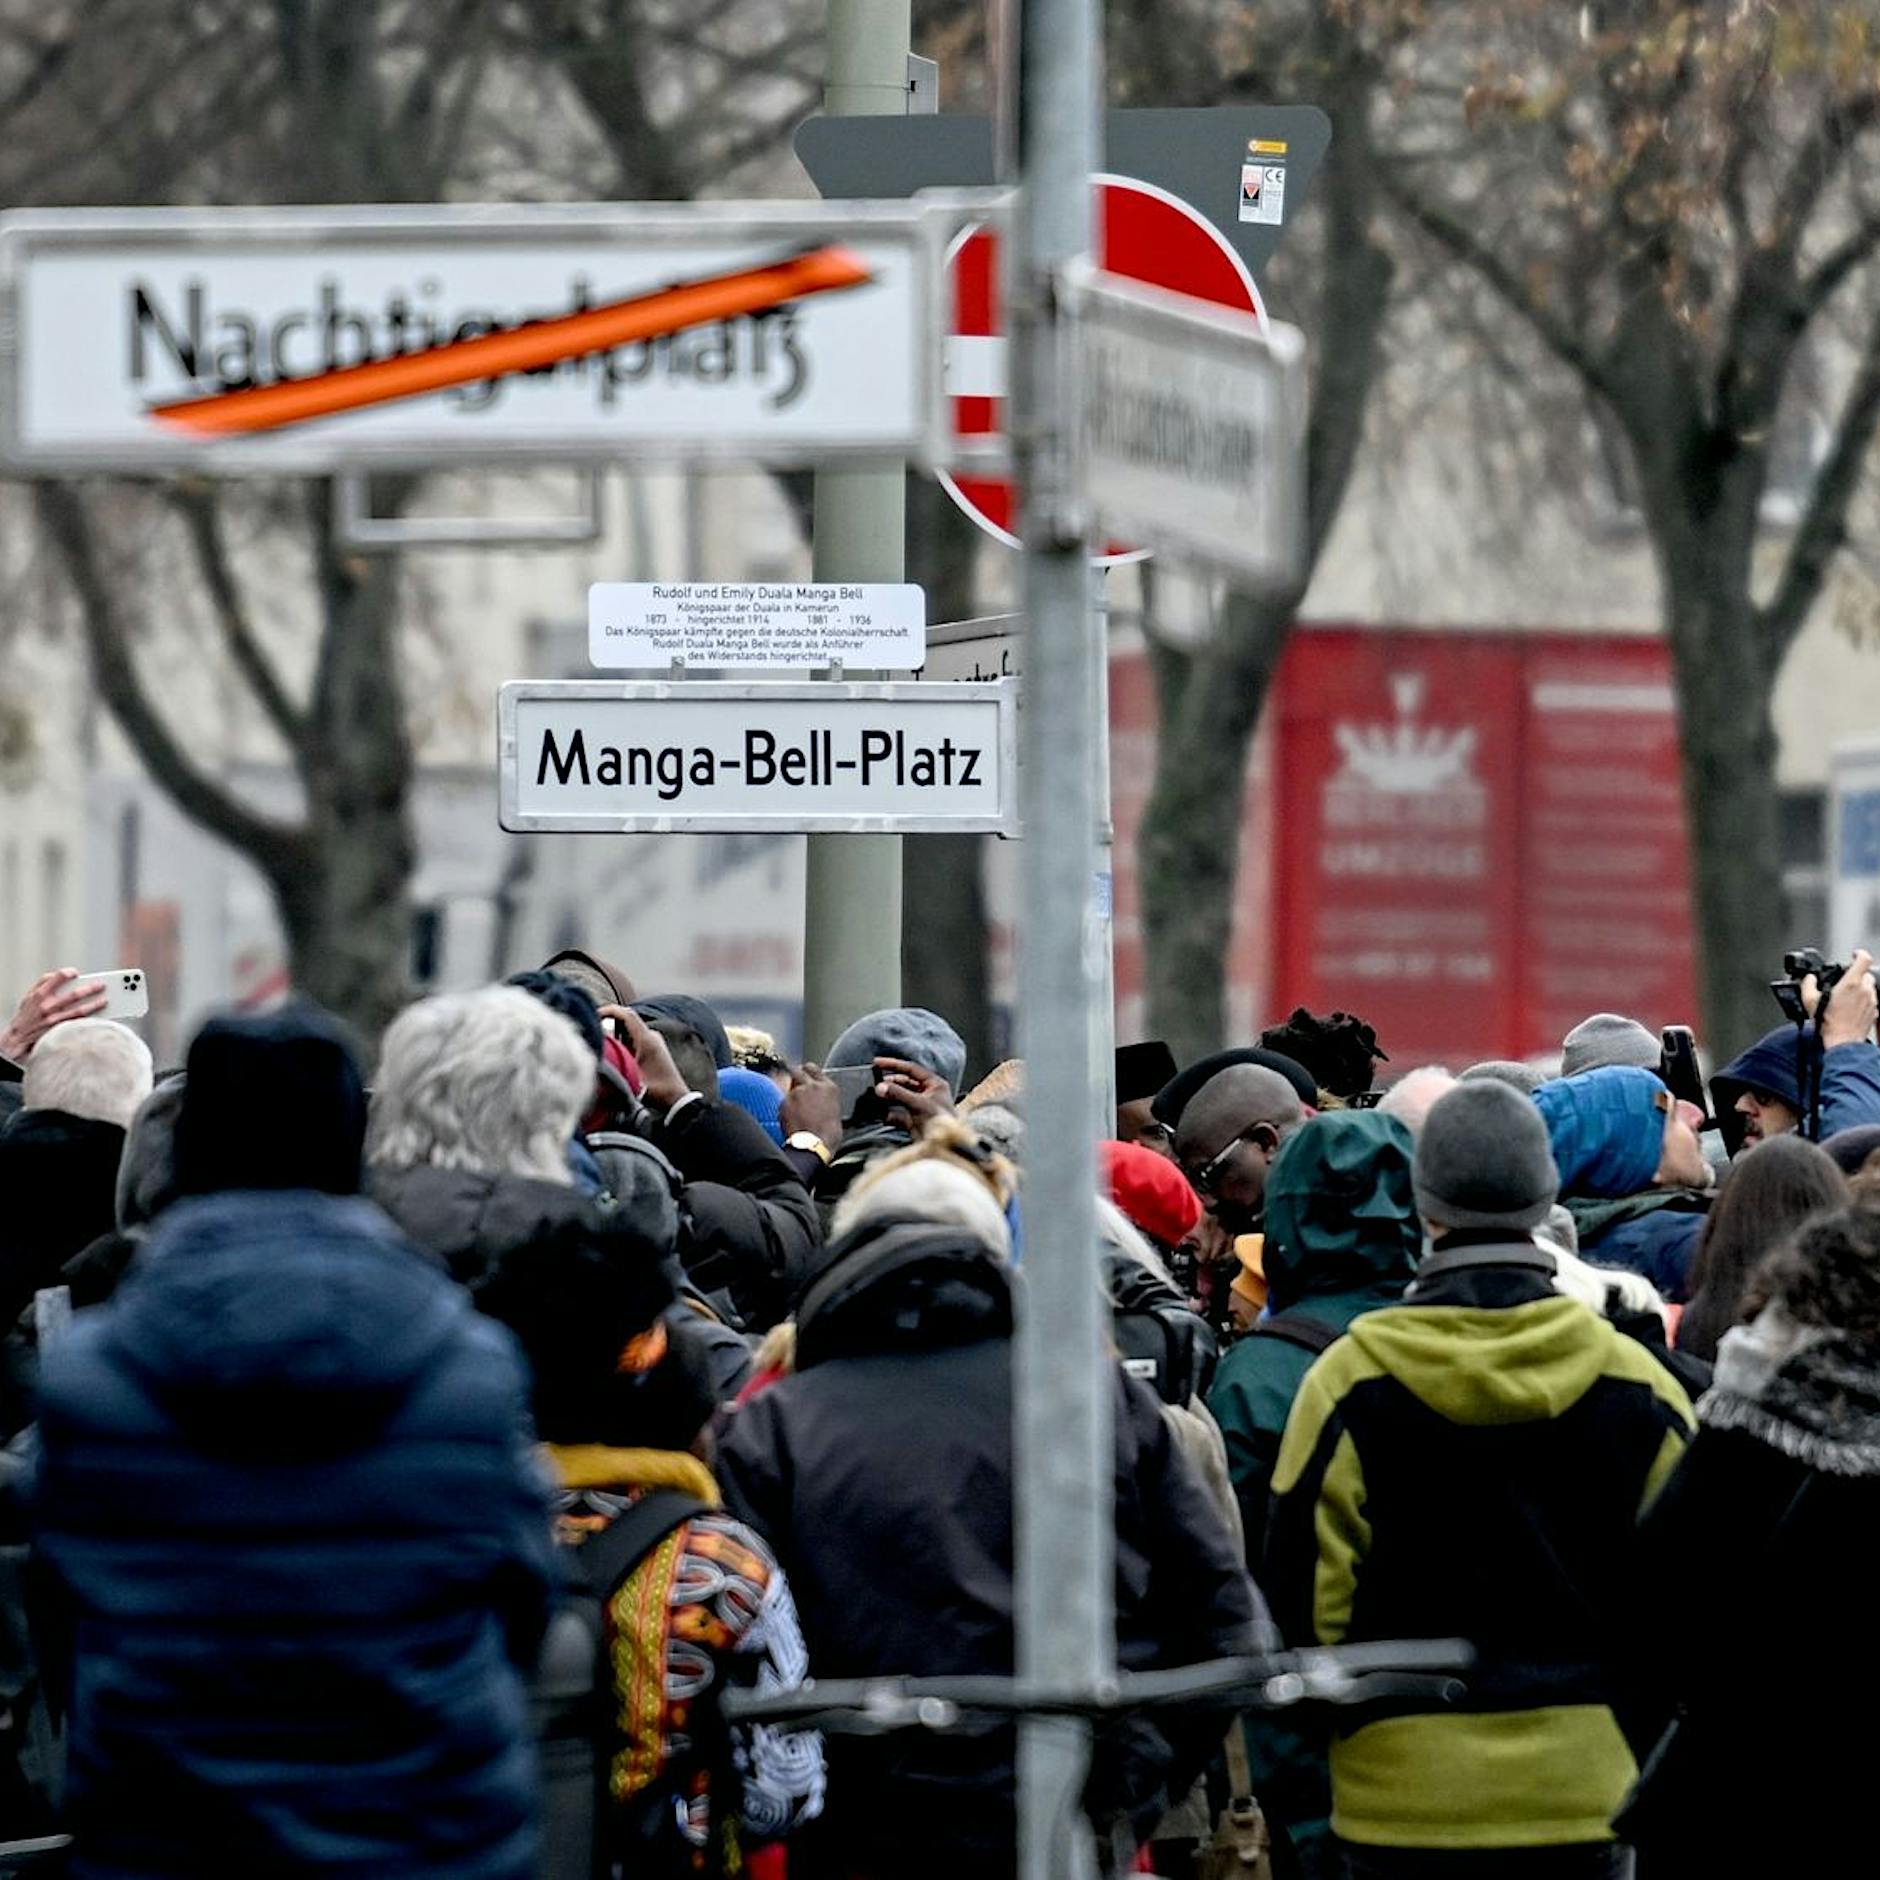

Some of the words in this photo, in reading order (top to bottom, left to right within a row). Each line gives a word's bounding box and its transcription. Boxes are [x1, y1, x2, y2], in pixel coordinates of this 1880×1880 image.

[126, 274, 808, 408] Nachtiglpatz
[652, 586, 692, 599] Rudolf
[695, 586, 718, 599] und
[721, 586, 756, 602] Emily
[758, 587, 793, 600] Duala
[796, 587, 837, 602] Manga
[839, 587, 863, 600] Bell
[677, 602, 732, 614] Königspaar
[734, 603, 750, 613] der
[753, 603, 781, 613] Duala
[783, 603, 793, 613] in
[795, 603, 840, 613] Kamerun
[645, 614, 667, 625] 1873
[688, 613, 745, 626] hingerichtet
[748, 614, 770, 625] 1914
[807, 615, 828, 625] 1881
[850, 615, 872, 625] 1936
[605, 626, 623, 637] Das
[626, 626, 681, 639] Königspaar
[684, 627, 724, 639] kämpfte
[726, 629, 756, 639] gegen
[758, 627, 773, 637] die
[775, 627, 818, 637] deutsche
[653, 638, 684, 649] Rudolf
[686, 638, 714, 649] Duala
[717, 638, 749, 650] Manga
[752, 639, 770, 649] Bell
[773, 639, 803, 649] wurde
[805, 639, 819, 649] als
[822, 639, 864, 649] Anführer
[688, 651, 705, 661] des
[708, 651, 768, 661] Widerstands
[537, 729, 983, 800] Manga-Bell-Platz
